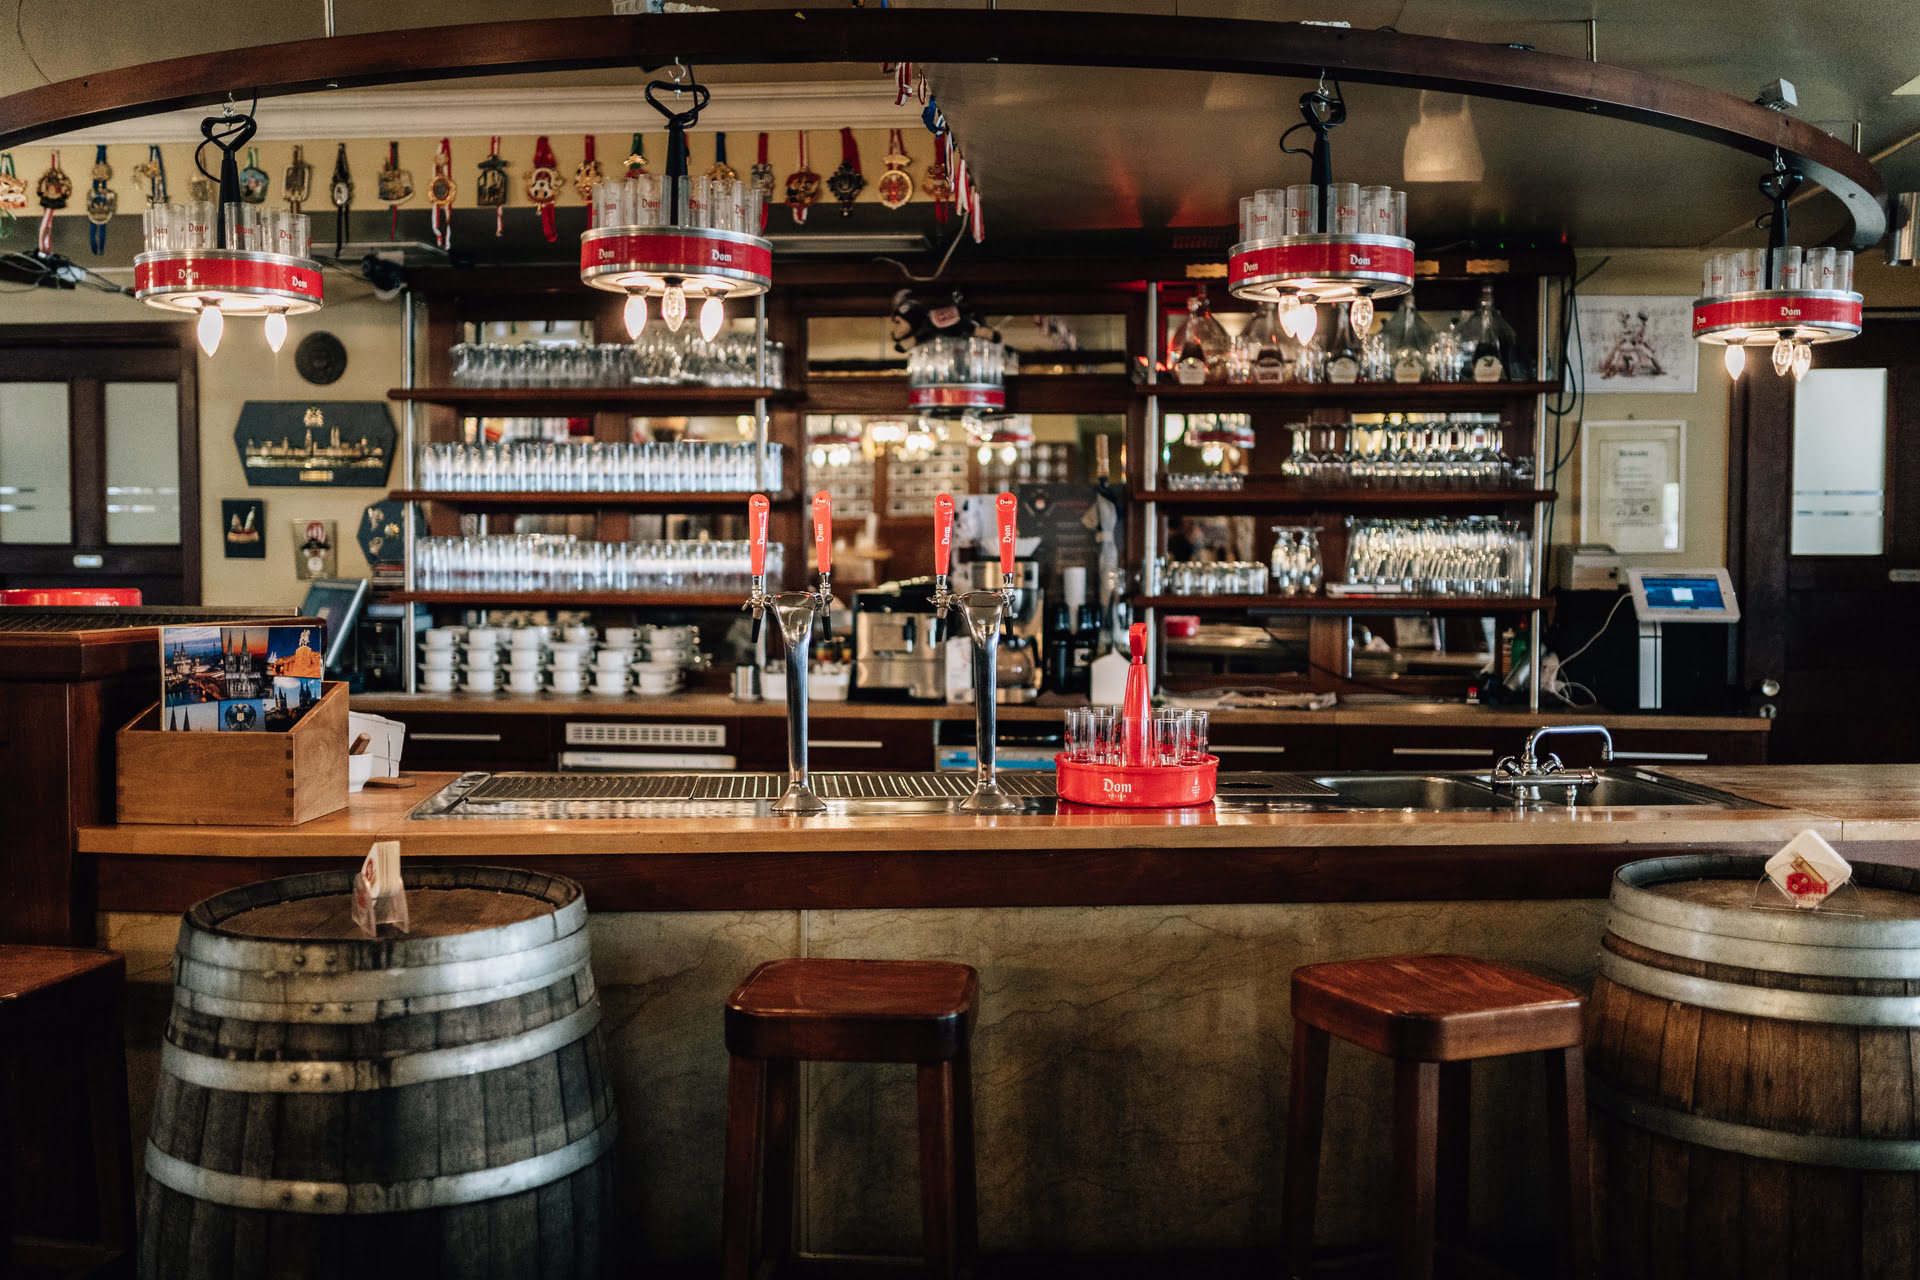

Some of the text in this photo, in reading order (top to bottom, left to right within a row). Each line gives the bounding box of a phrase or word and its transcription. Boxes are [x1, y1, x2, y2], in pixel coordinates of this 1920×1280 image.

[598, 249, 615, 259] Dom
[711, 249, 732, 261] Dom
[1350, 254, 1371, 265] Dom
[1243, 262, 1259, 272] Dom
[292, 276, 307, 288] Dom
[1781, 307, 1801, 316] Dom
[816, 523, 824, 542] Dom
[941, 526, 951, 545] Dom
[1002, 524, 1011, 544] Dom
[1103, 778, 1132, 792] Dom
